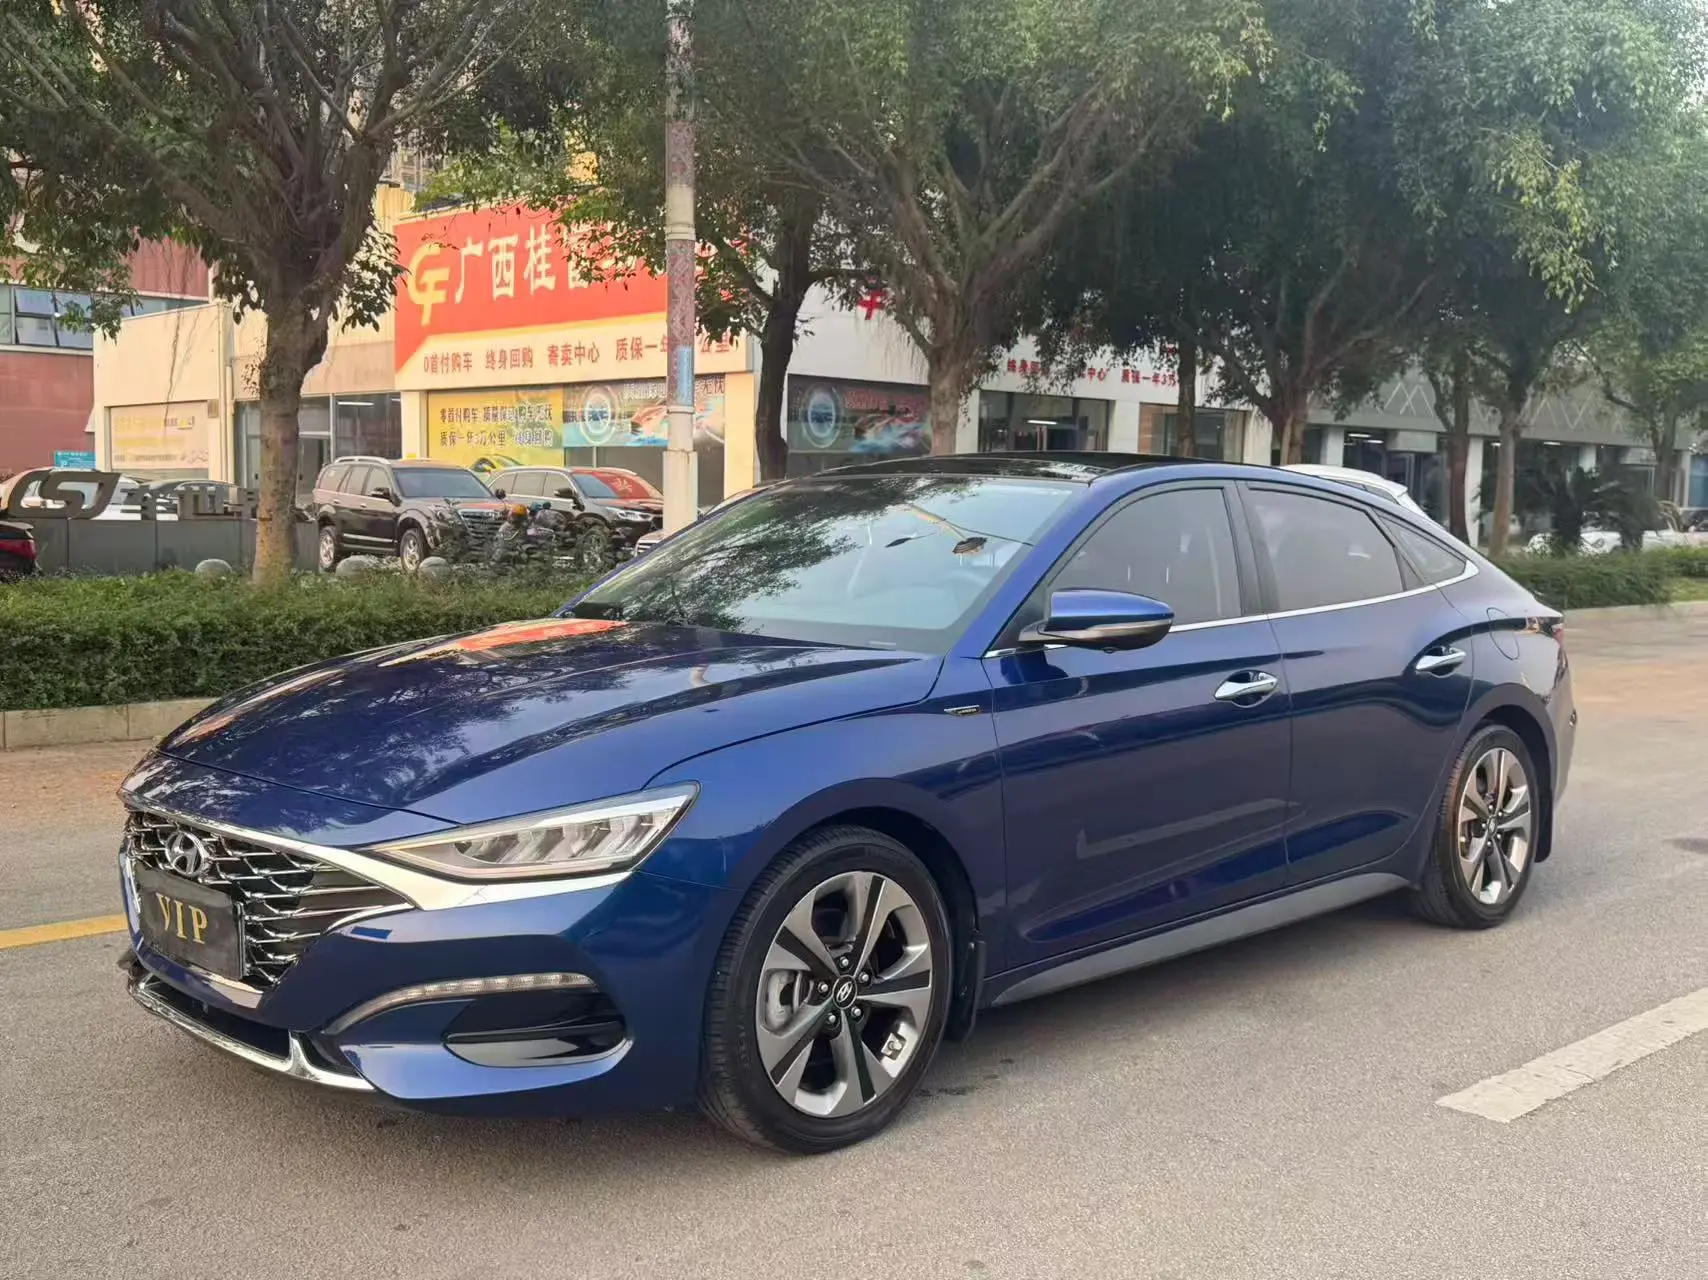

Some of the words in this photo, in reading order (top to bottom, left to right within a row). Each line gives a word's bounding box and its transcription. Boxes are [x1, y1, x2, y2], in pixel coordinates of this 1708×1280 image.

[423, 351, 473, 375] 0首付购车
[485, 345, 534, 370] 终身回购
[547, 339, 600, 367] 寄卖中心
[615, 332, 730, 361] 质保一年公里
[155, 892, 207, 944] VIP
